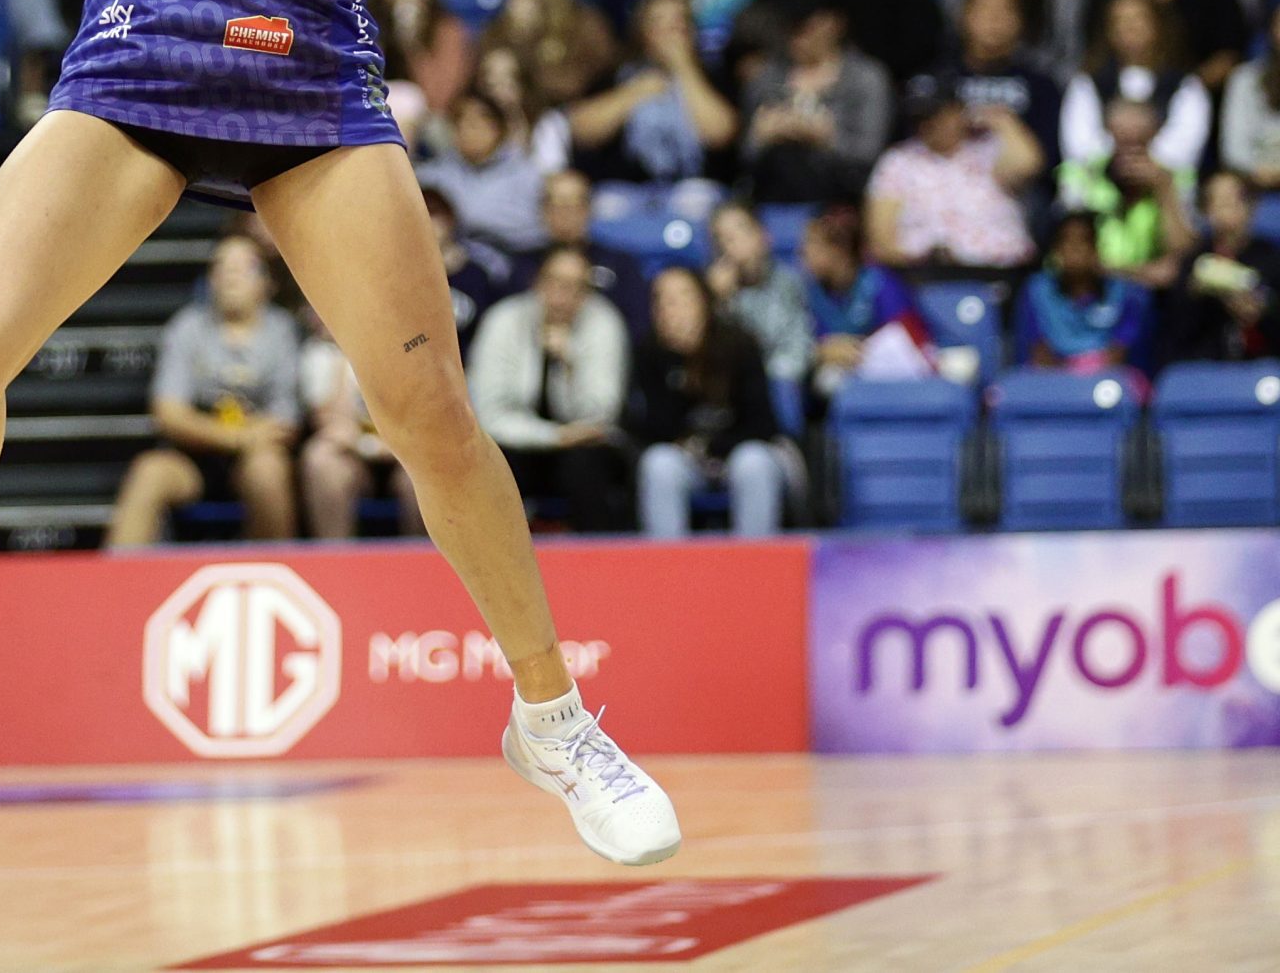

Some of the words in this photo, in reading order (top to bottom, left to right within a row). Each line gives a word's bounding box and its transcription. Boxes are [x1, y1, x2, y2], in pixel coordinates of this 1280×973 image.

[228, 37, 286, 50] WAREHOUSE
[229, 25, 290, 44] CHEMIST
[164, 579, 324, 737] MG
[368, 630, 460, 683] MG
[462, 630, 612, 682] Mor
[853, 570, 1246, 730] myob
